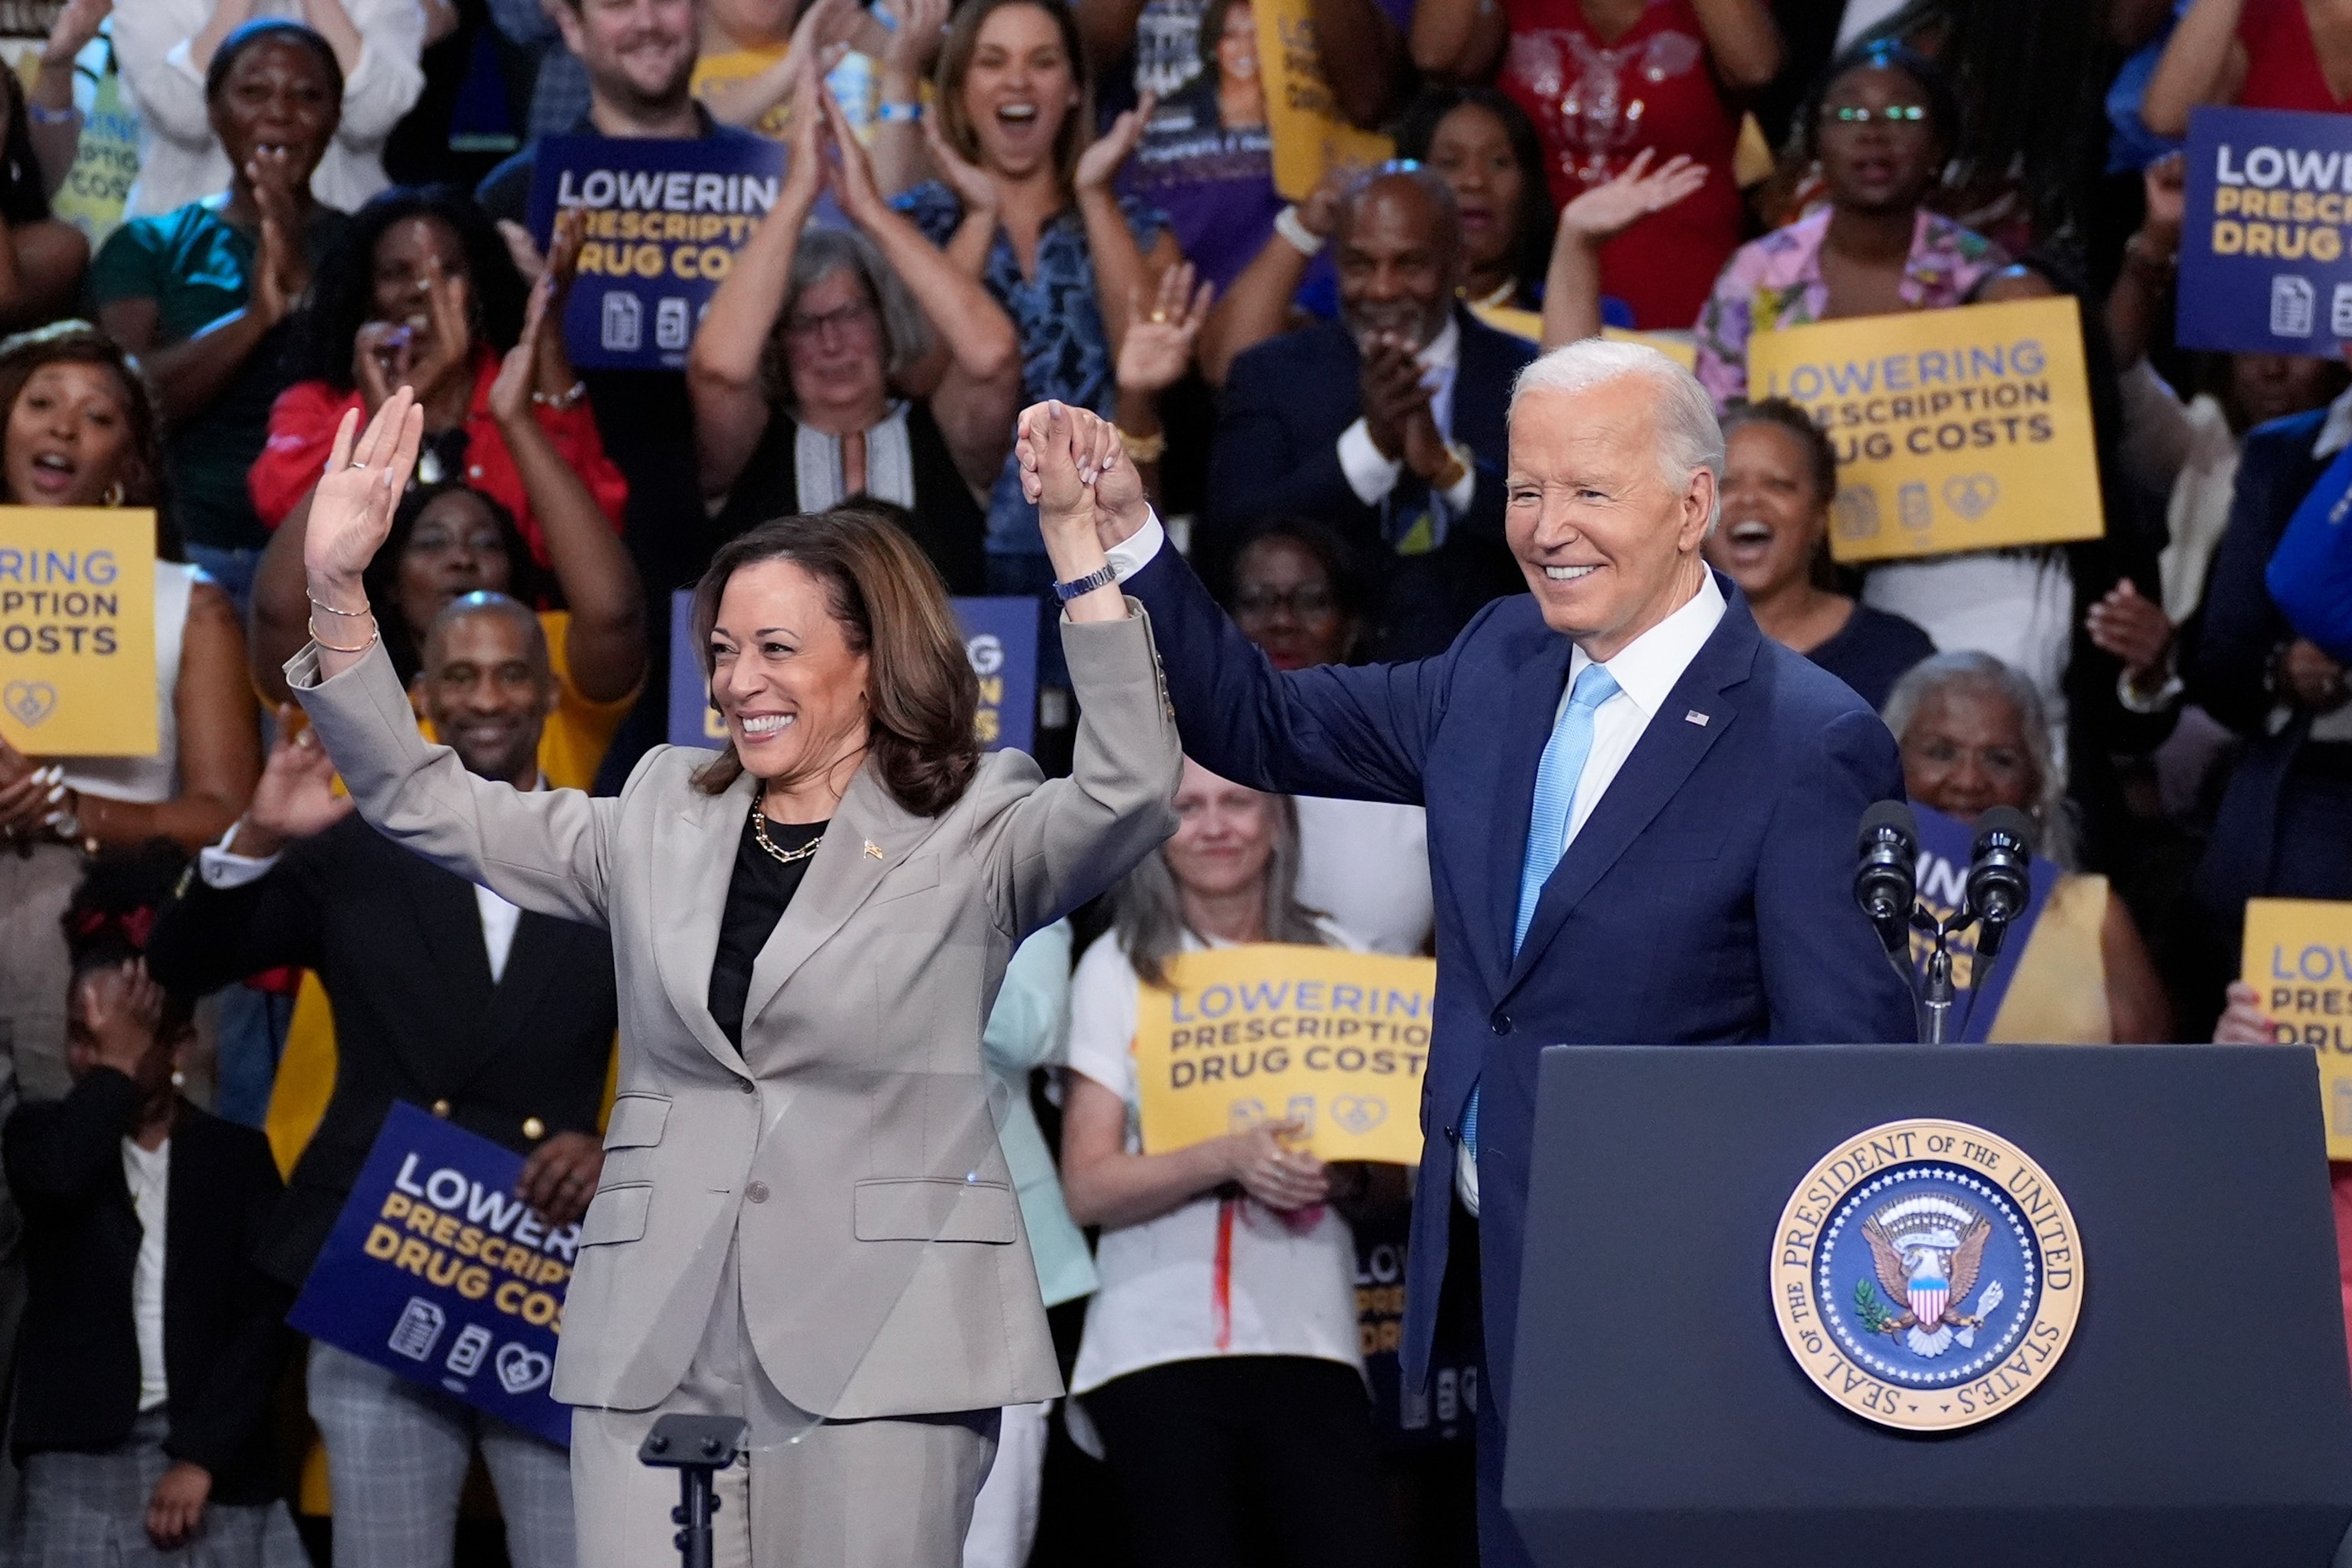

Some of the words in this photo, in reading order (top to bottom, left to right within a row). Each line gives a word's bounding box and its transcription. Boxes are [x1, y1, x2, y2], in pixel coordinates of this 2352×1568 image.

[557, 170, 778, 213] LOWERIN
[577, 242, 664, 278] RUG
[2213, 219, 2341, 261] DRUG
[1811, 381, 2051, 430] ESCRIPTION
[1906, 413, 2053, 456] COSTS
[0, 547, 118, 587] RING
[3, 590, 118, 617] PTION
[3, 623, 118, 656] OSTS
[1171, 981, 1434, 1024] LOWERIN
[1171, 1017, 1431, 1052] PRESCRIPTIO
[1171, 1047, 1291, 1090] DRUG
[1305, 1046, 1428, 1078] COST
[1928, 1135, 1956, 1153] OF
[1962, 1140, 2001, 1170] THE
[1783, 1132, 1916, 1267] PRESIDENT
[381, 1191, 574, 1286] PRESCRIPT
[2008, 1168, 2073, 1291] UNITED
[363, 1223, 493, 1299] DRUG
[1788, 1281, 1808, 1324] THE
[1799, 1328, 1822, 1354] OF
[1824, 1352, 1901, 1414] SEAL
[1958, 1320, 2060, 1414] STATES
